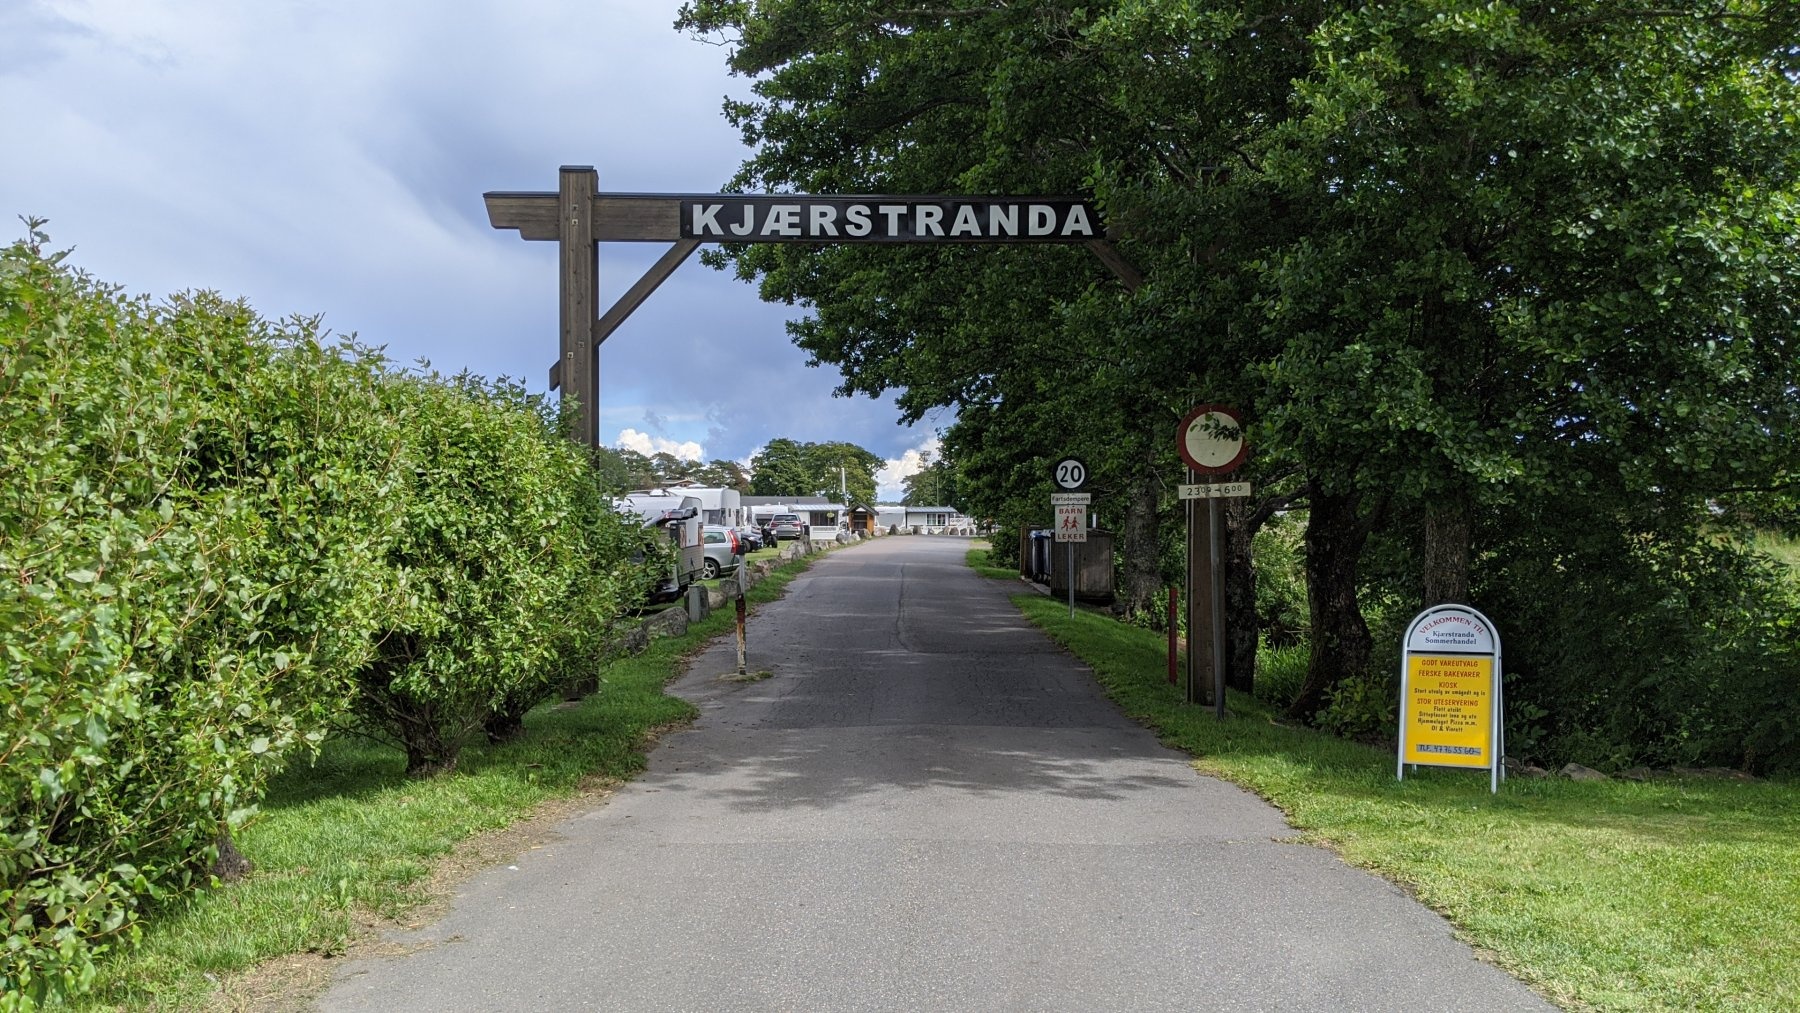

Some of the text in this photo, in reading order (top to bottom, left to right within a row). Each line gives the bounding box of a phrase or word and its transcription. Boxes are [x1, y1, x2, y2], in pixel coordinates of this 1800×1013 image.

[692, 204, 1093, 236] KJÆRSTRANDA
[1060, 465, 1082, 483] 20
[1419, 616, 1484, 635] VELKOMMEN TIL
[1421, 659, 1438, 667] GODT
[1418, 670, 1481, 679] FERSKE BAKEVARER
[1433, 699, 1479, 707] UTESERVERING
